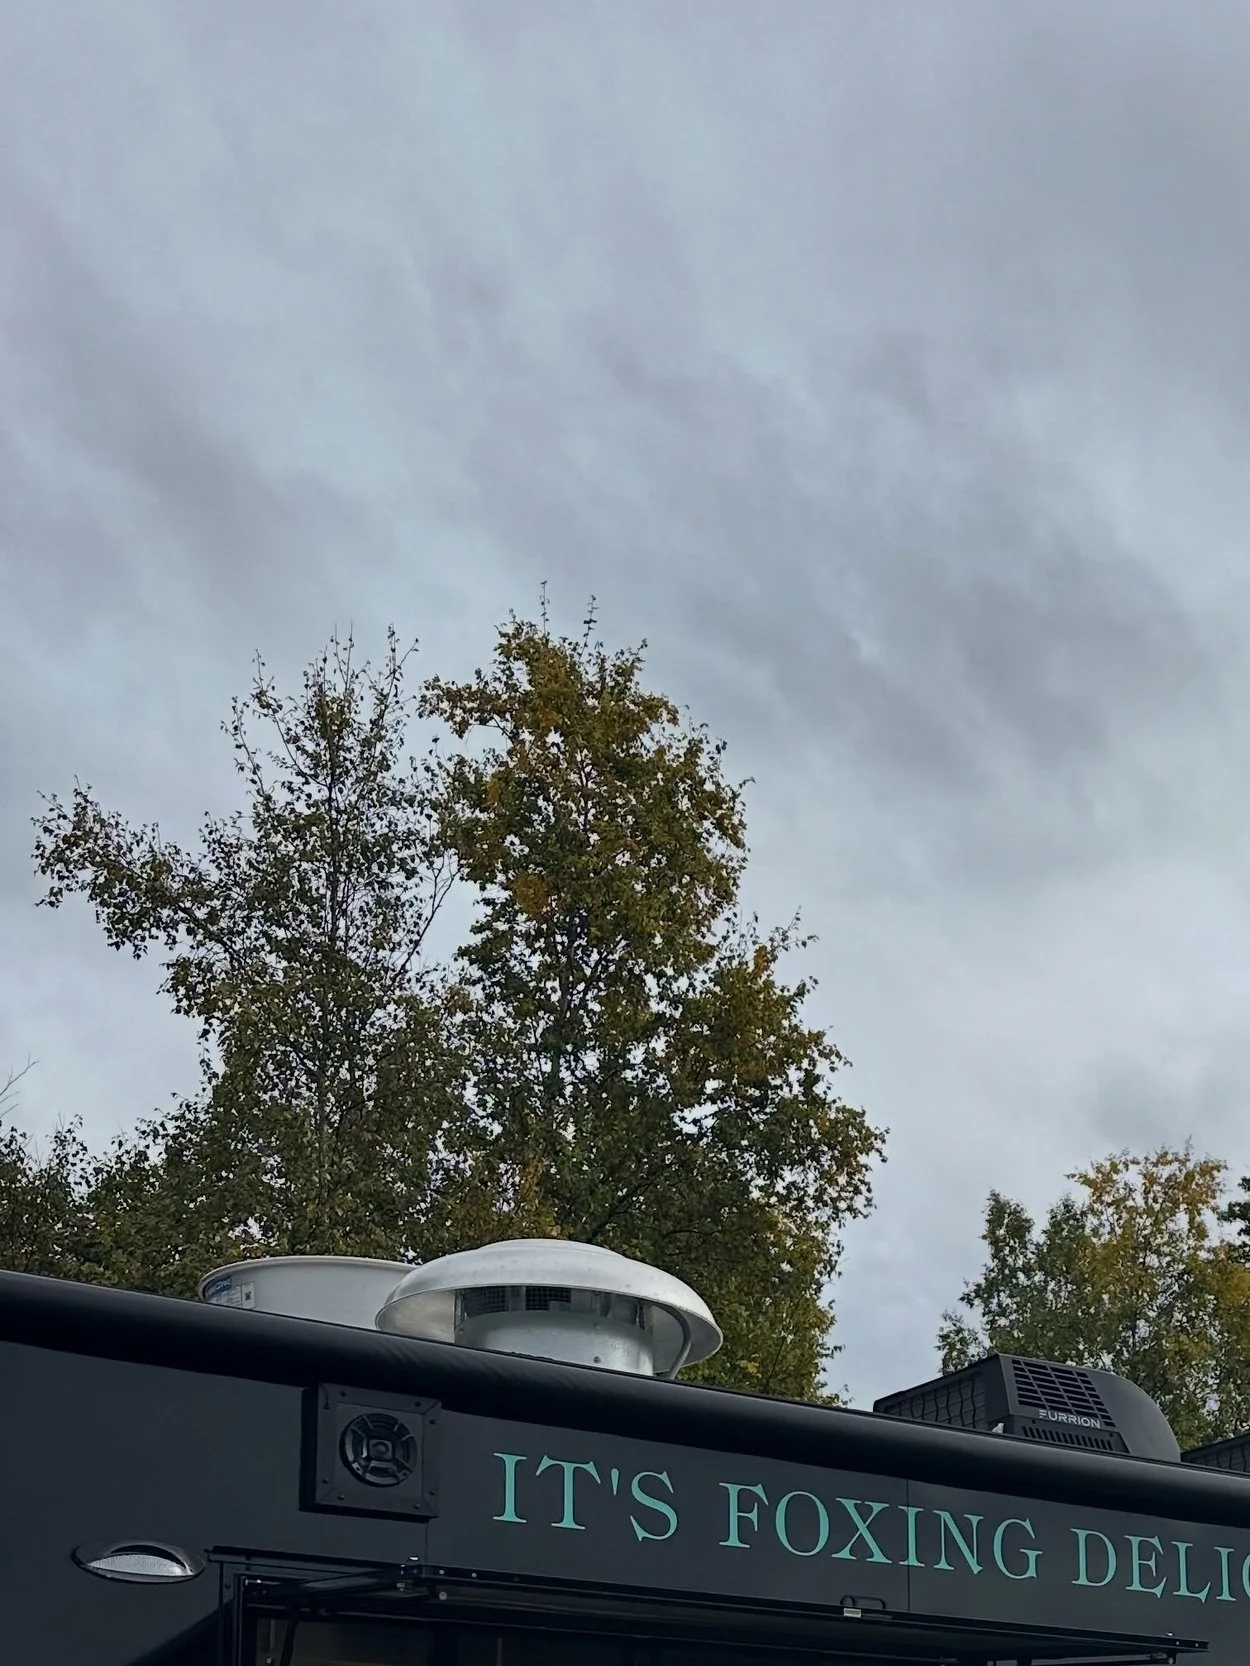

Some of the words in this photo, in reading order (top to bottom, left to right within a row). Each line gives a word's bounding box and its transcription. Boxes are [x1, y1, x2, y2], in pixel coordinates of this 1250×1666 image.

[1038, 1408, 1101, 1429] FURRION
[493, 1451, 679, 1542] IT'S
[718, 1481, 1043, 1580] FOXING
